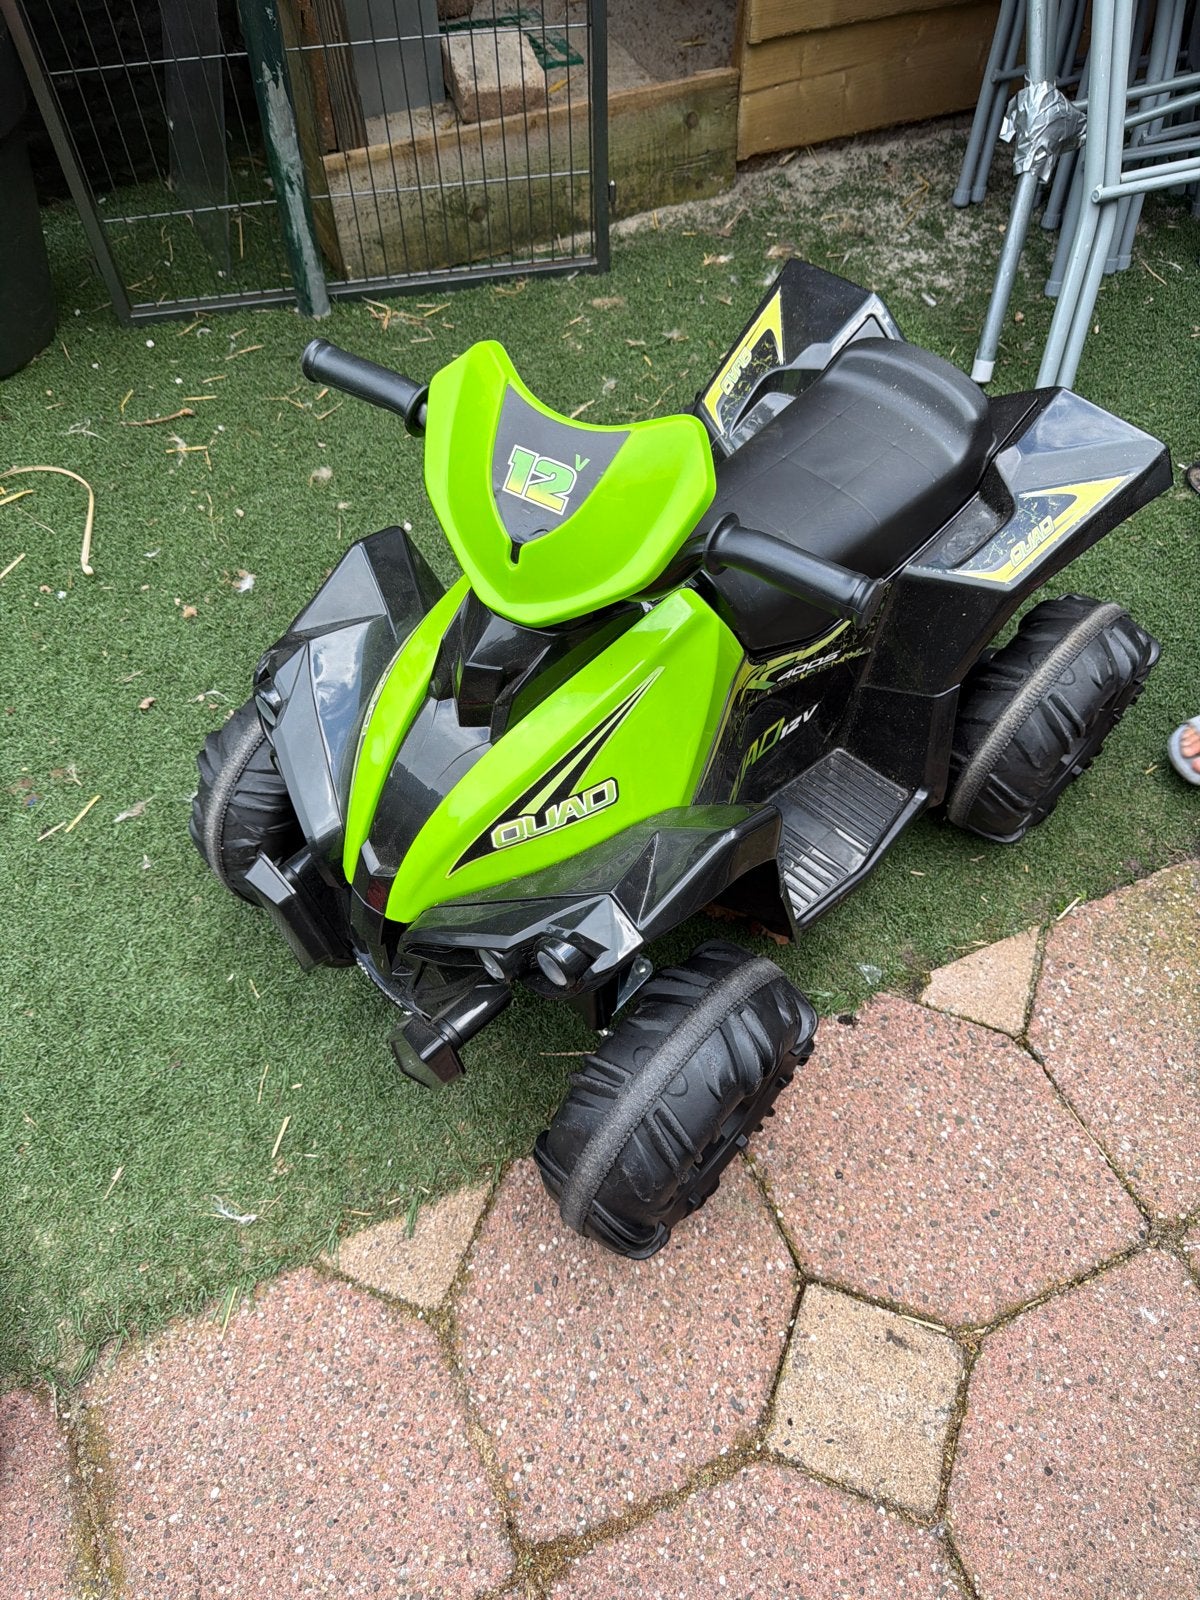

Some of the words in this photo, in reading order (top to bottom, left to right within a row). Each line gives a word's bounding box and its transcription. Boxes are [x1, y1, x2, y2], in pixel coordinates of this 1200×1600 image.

[1010, 515, 1055, 568] QUAD
[777, 649, 841, 682] 400S
[491, 778, 618, 849] QUAD
